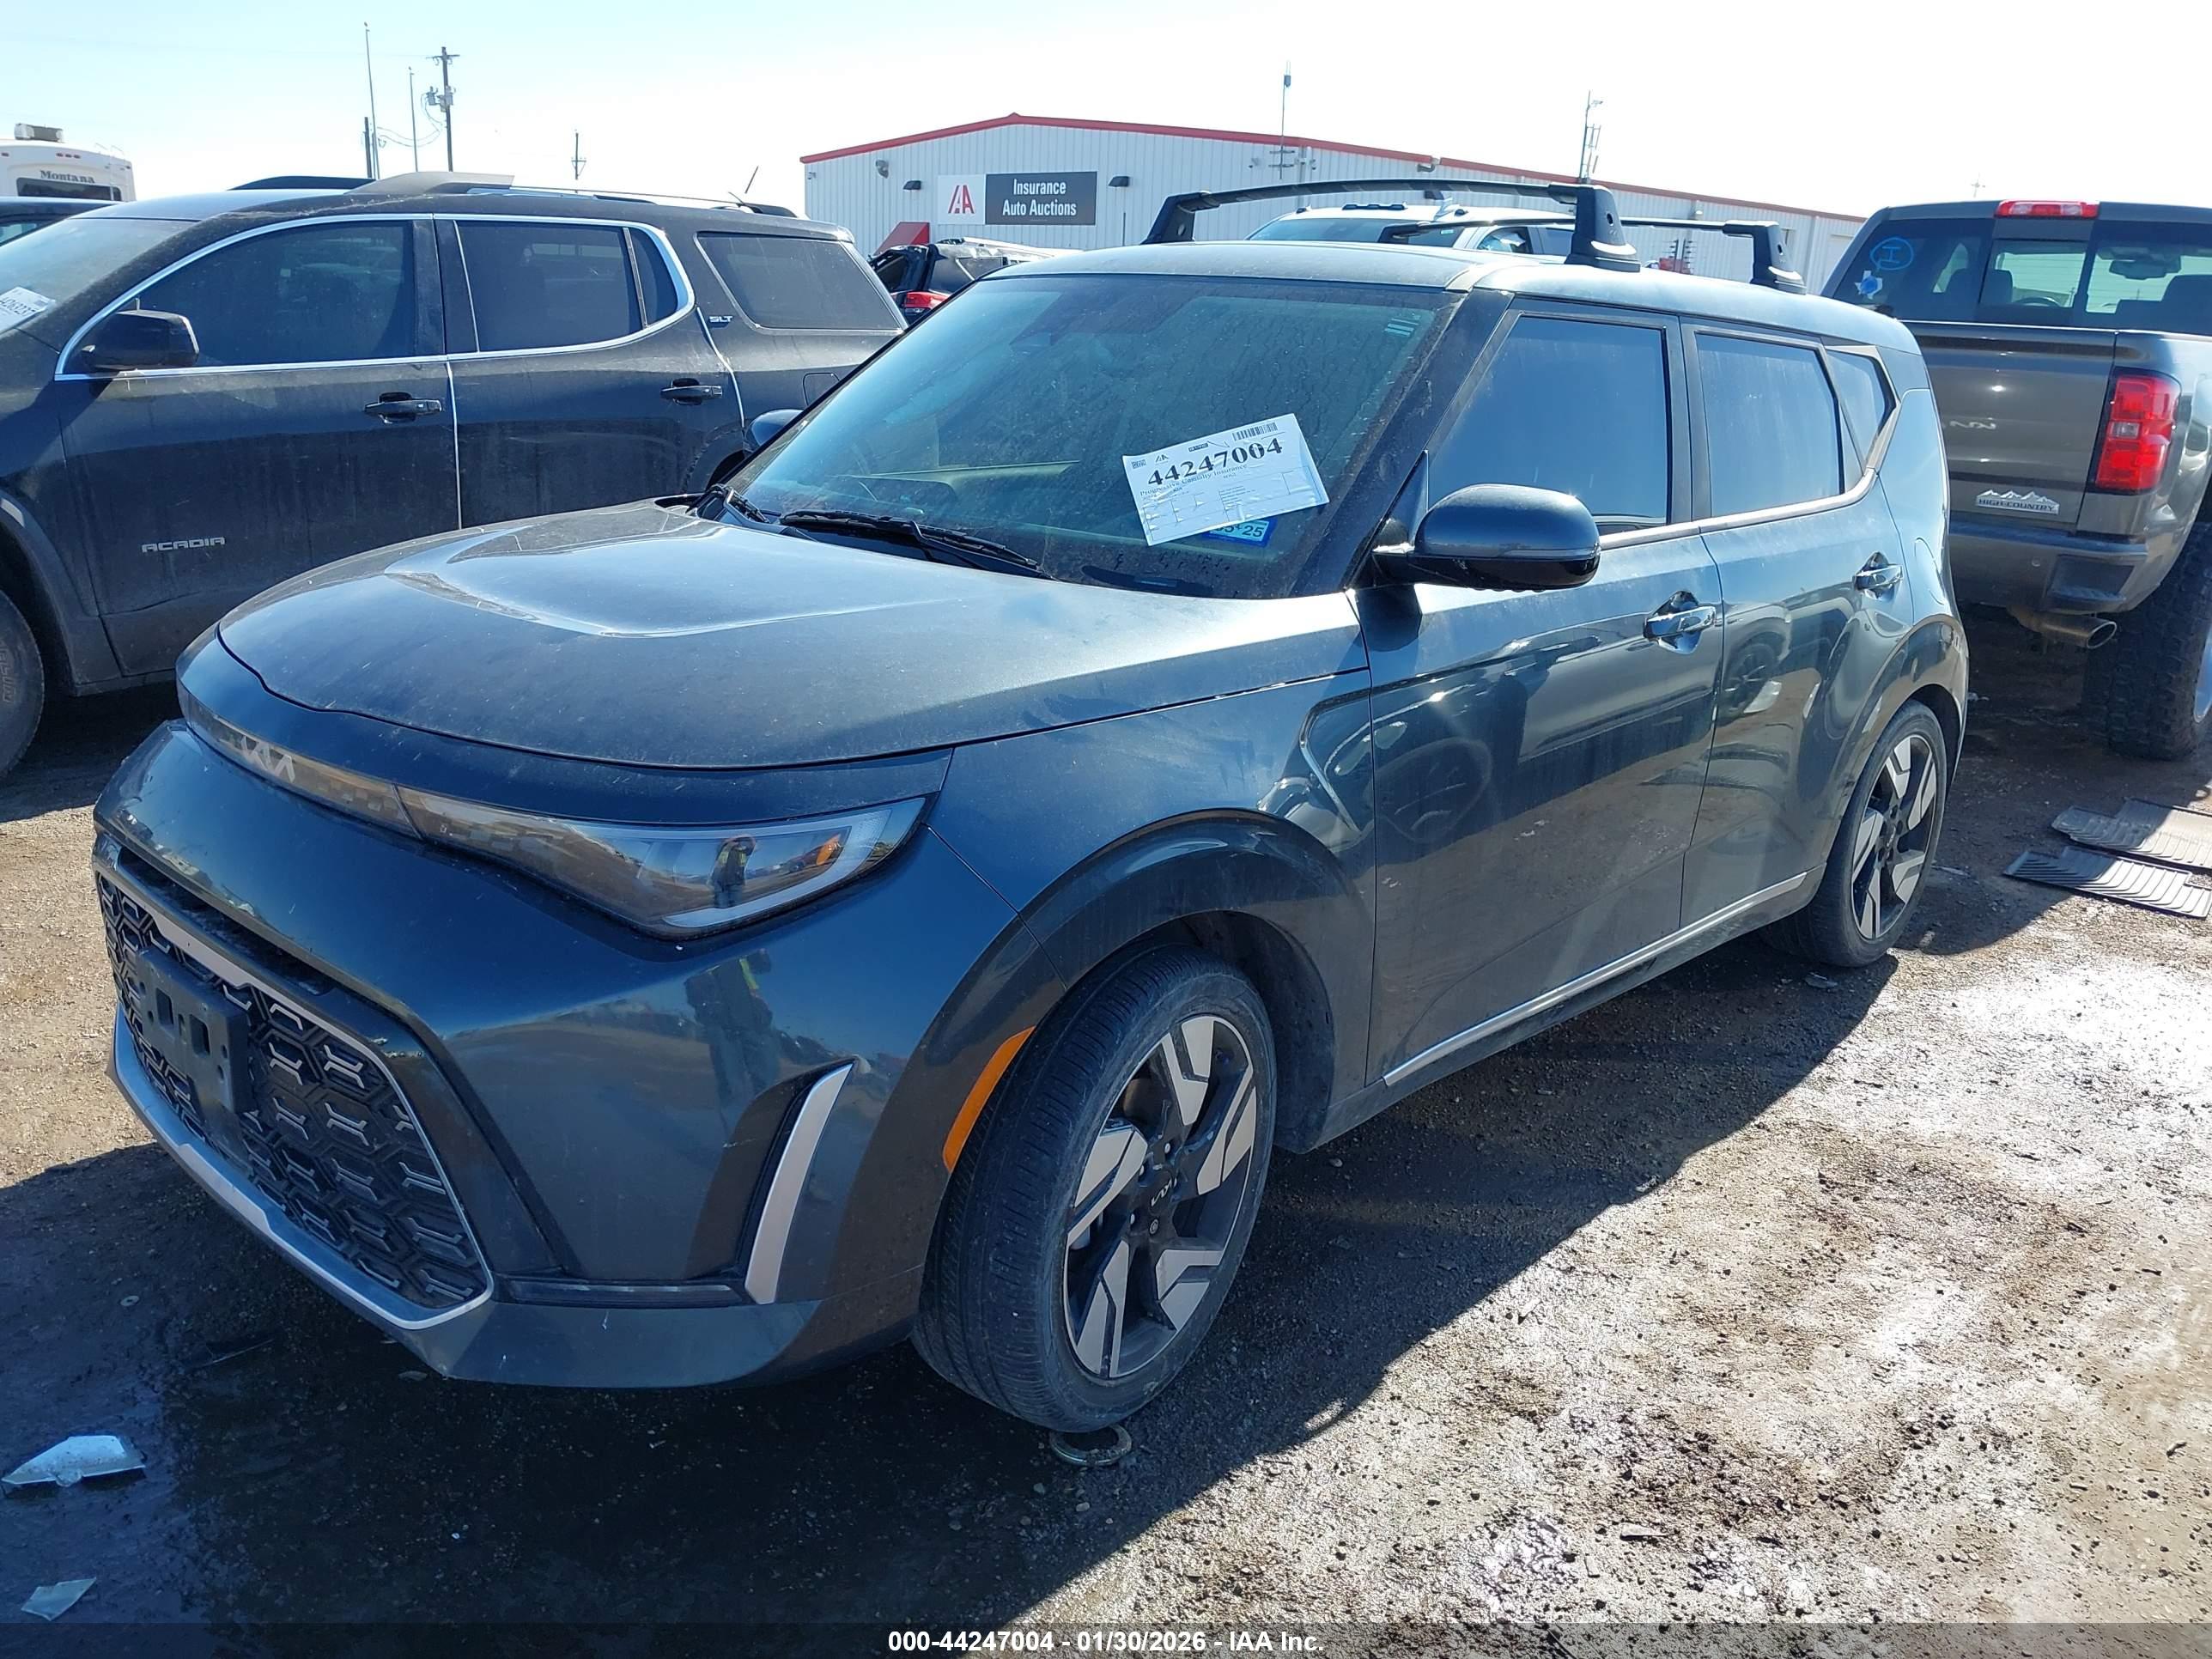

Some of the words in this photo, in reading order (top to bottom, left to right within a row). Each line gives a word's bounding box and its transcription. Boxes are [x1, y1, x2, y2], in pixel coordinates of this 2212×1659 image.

[40, 170, 95, 184] Montana
[1013, 178, 1066, 195] Insurance
[1002, 199, 1027, 216] Auto
[1029, 198, 1078, 216] Auctions
[1147, 437, 1283, 486] 44247004
[2006, 501, 2055, 513] COUNTRY
[1242, 525, 1265, 538] 25
[141, 537, 226, 553] ACADIA
